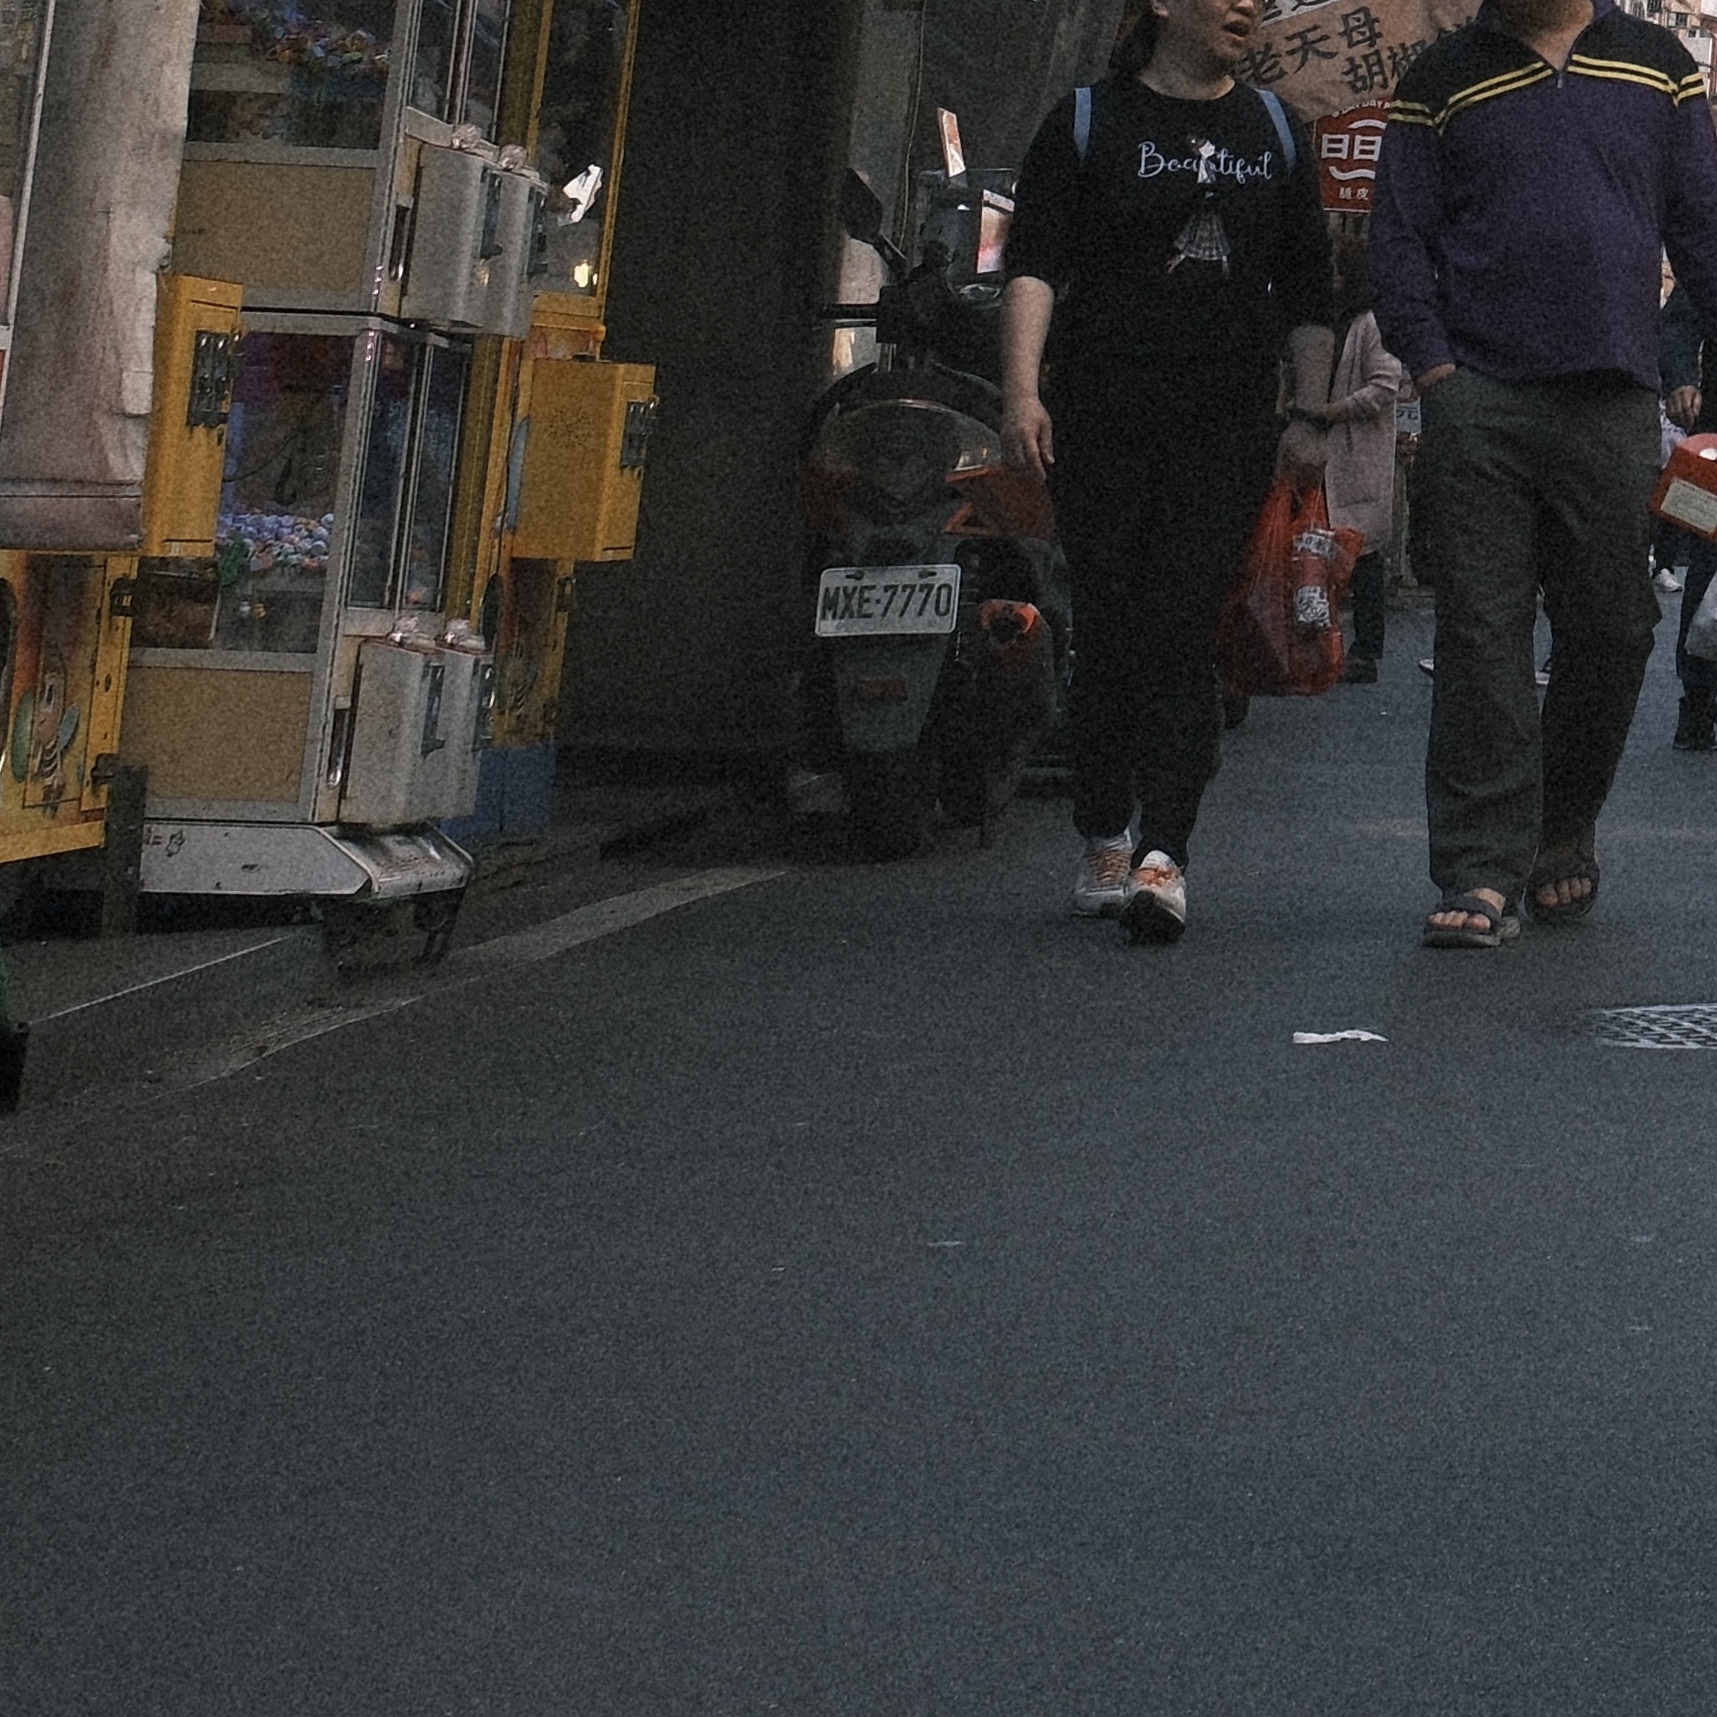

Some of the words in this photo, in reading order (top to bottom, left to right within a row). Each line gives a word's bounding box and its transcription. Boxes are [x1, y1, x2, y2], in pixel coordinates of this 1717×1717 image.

[1240, 5, 1384, 86] 老天母
[1138, 141, 1272, 184] Beautiful
[820, 583, 953, 621] MXE-7770
